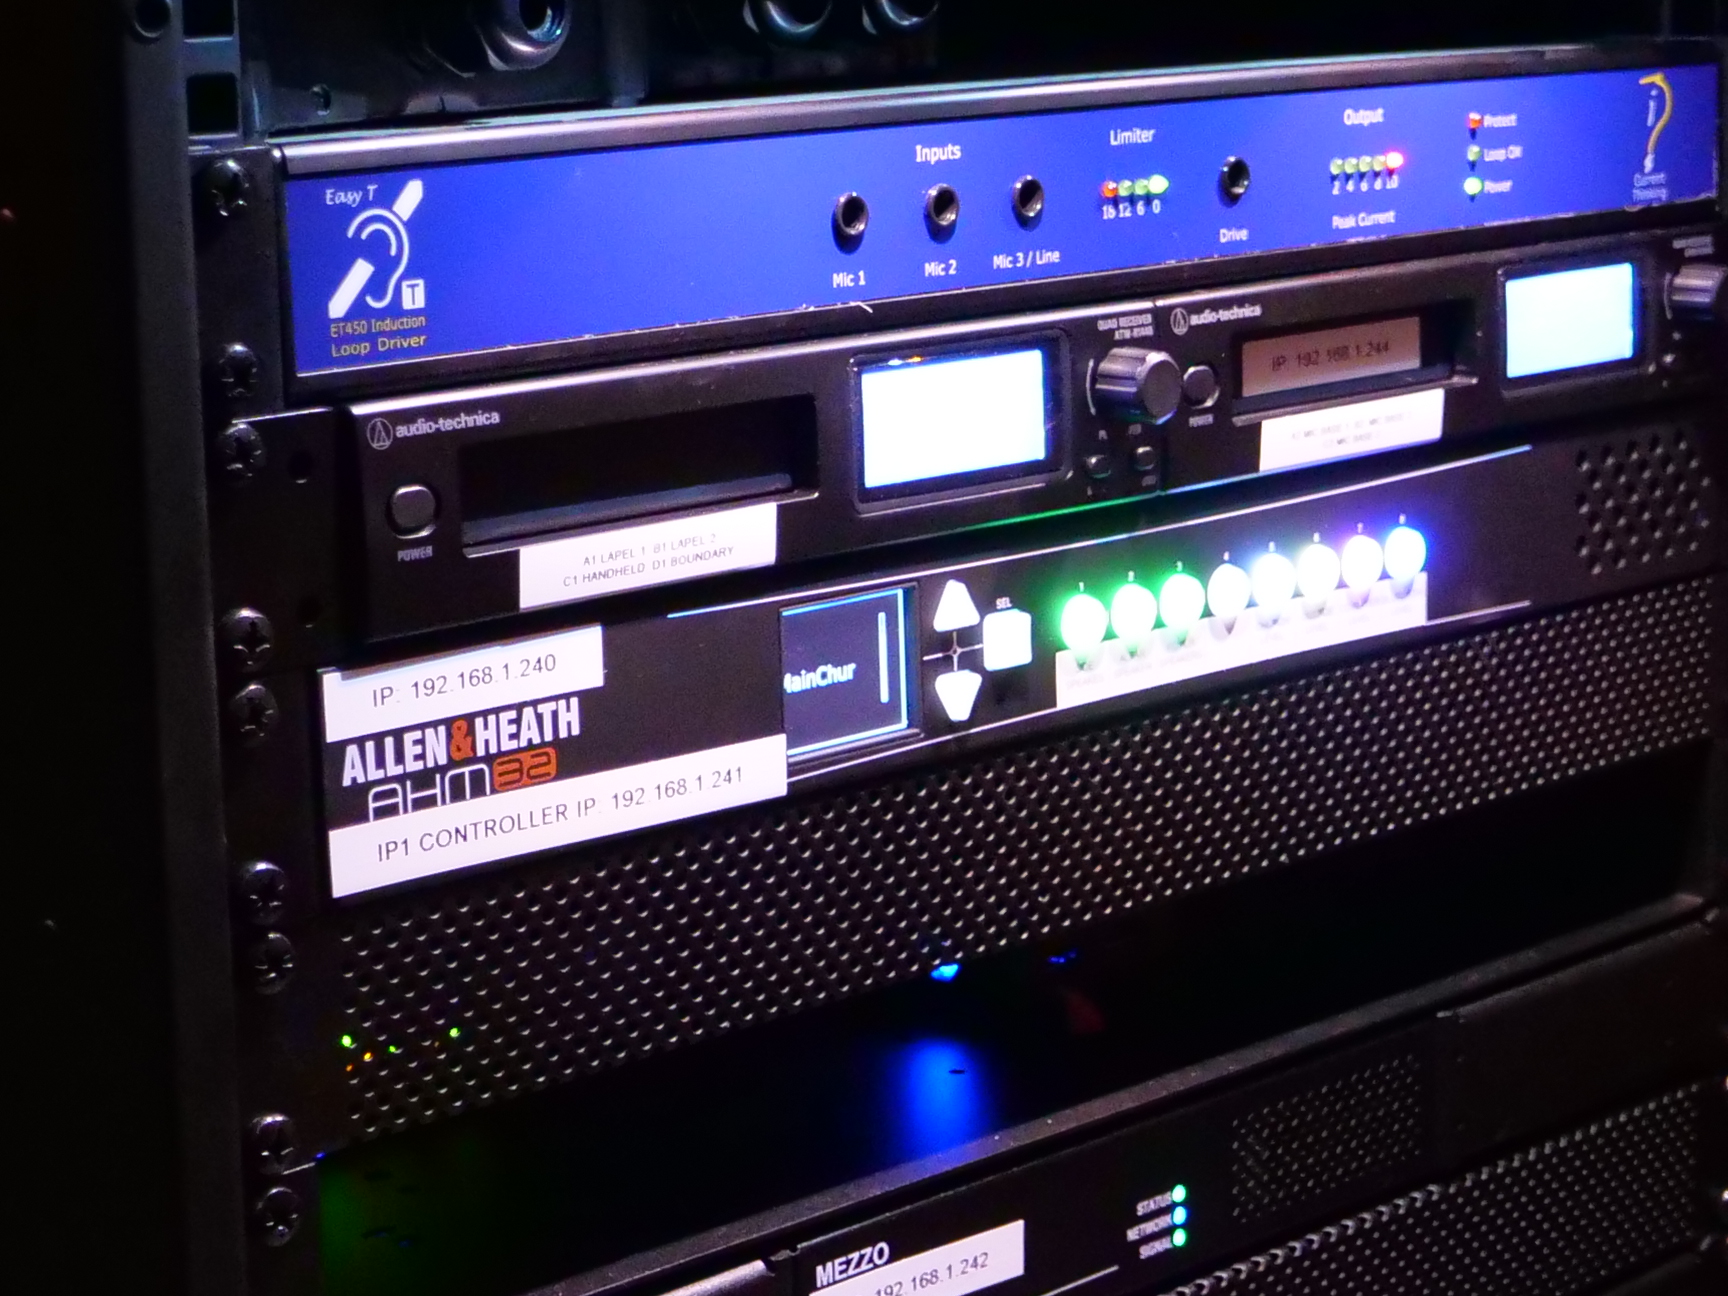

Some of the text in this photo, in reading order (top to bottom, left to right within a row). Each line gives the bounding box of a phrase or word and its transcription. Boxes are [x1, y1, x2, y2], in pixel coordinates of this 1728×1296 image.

[1343, 107, 1384, 127] Output
[1110, 128, 1156, 146] Limiter
[915, 143, 962, 165] Inputs
[325, 185, 378, 207] Easy T
[1118, 202, 1132, 218] 12
[1136, 200, 1146, 216] 6
[1152, 199, 1161, 214] 0
[1332, 210, 1396, 230] Peak Current
[1219, 227, 1248, 243] Drive
[925, 260, 957, 277] Mic 2
[993, 253, 1014, 269] Mic
[1015, 253, 1024, 268] 3
[1036, 249, 1060, 265] Line
[833, 271, 866, 288] Mic 1
[330, 315, 426, 338] ET450 Induction
[1190, 305, 1262, 327] audio-technica
[331, 333, 427, 358] Loop Driver
[395, 410, 500, 439] audio-technica
[397, 545, 433, 562] POWER
[583, 554, 597, 567] A1
[601, 548, 635, 565] LAPEL
[671, 535, 706, 552] LAPEL
[563, 546, 734, 587] C1 HANDHELD D1 BOUNDARY
[996, 597, 1012, 609] SEL
[378, 837, 410, 862] IP1
[420, 804, 569, 852] CONTROLLER
[1136, 1191, 1172, 1216] STATUS
[816, 1241, 890, 1287] MEZZO
